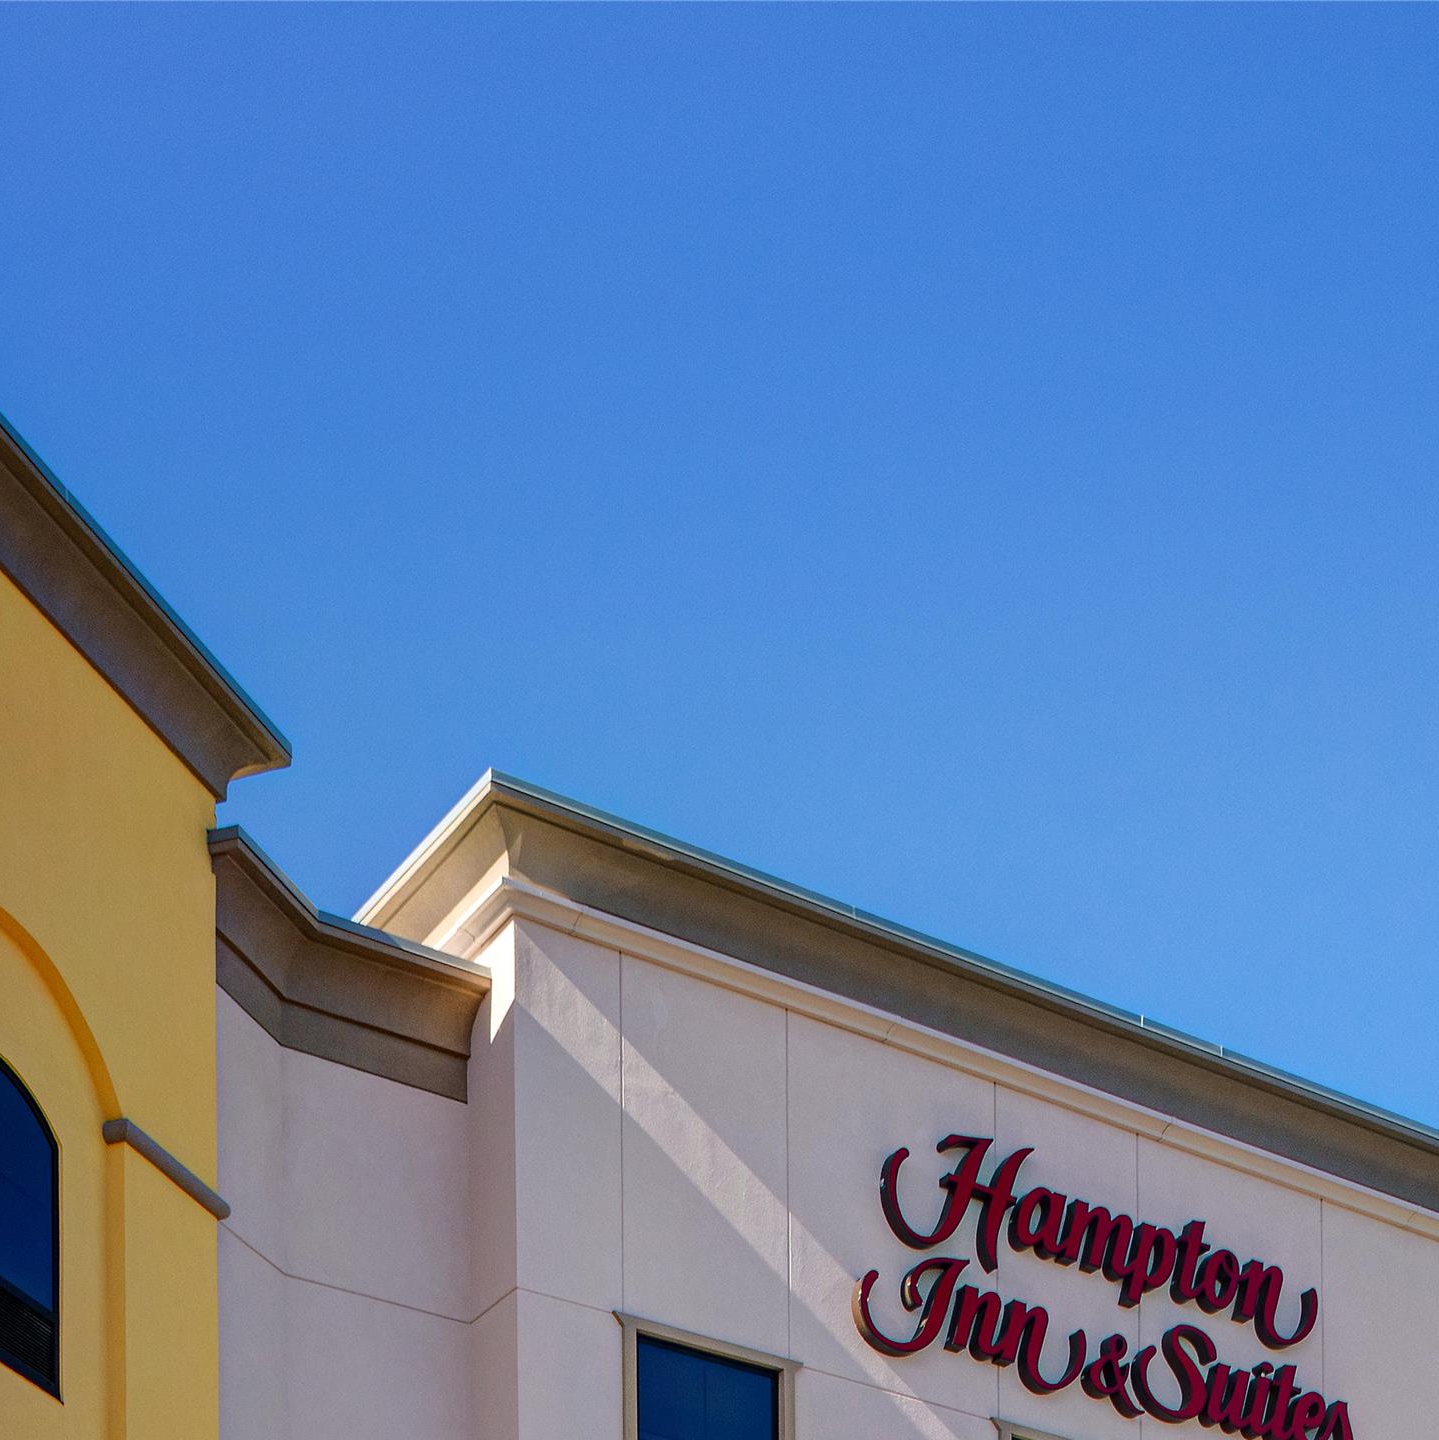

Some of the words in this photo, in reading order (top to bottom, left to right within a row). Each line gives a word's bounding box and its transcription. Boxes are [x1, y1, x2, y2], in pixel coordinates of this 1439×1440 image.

[880, 1133, 1318, 1351] Hampton
[852, 1258, 1086, 1396] Inn
[1081, 1333, 1145, 1419] &
